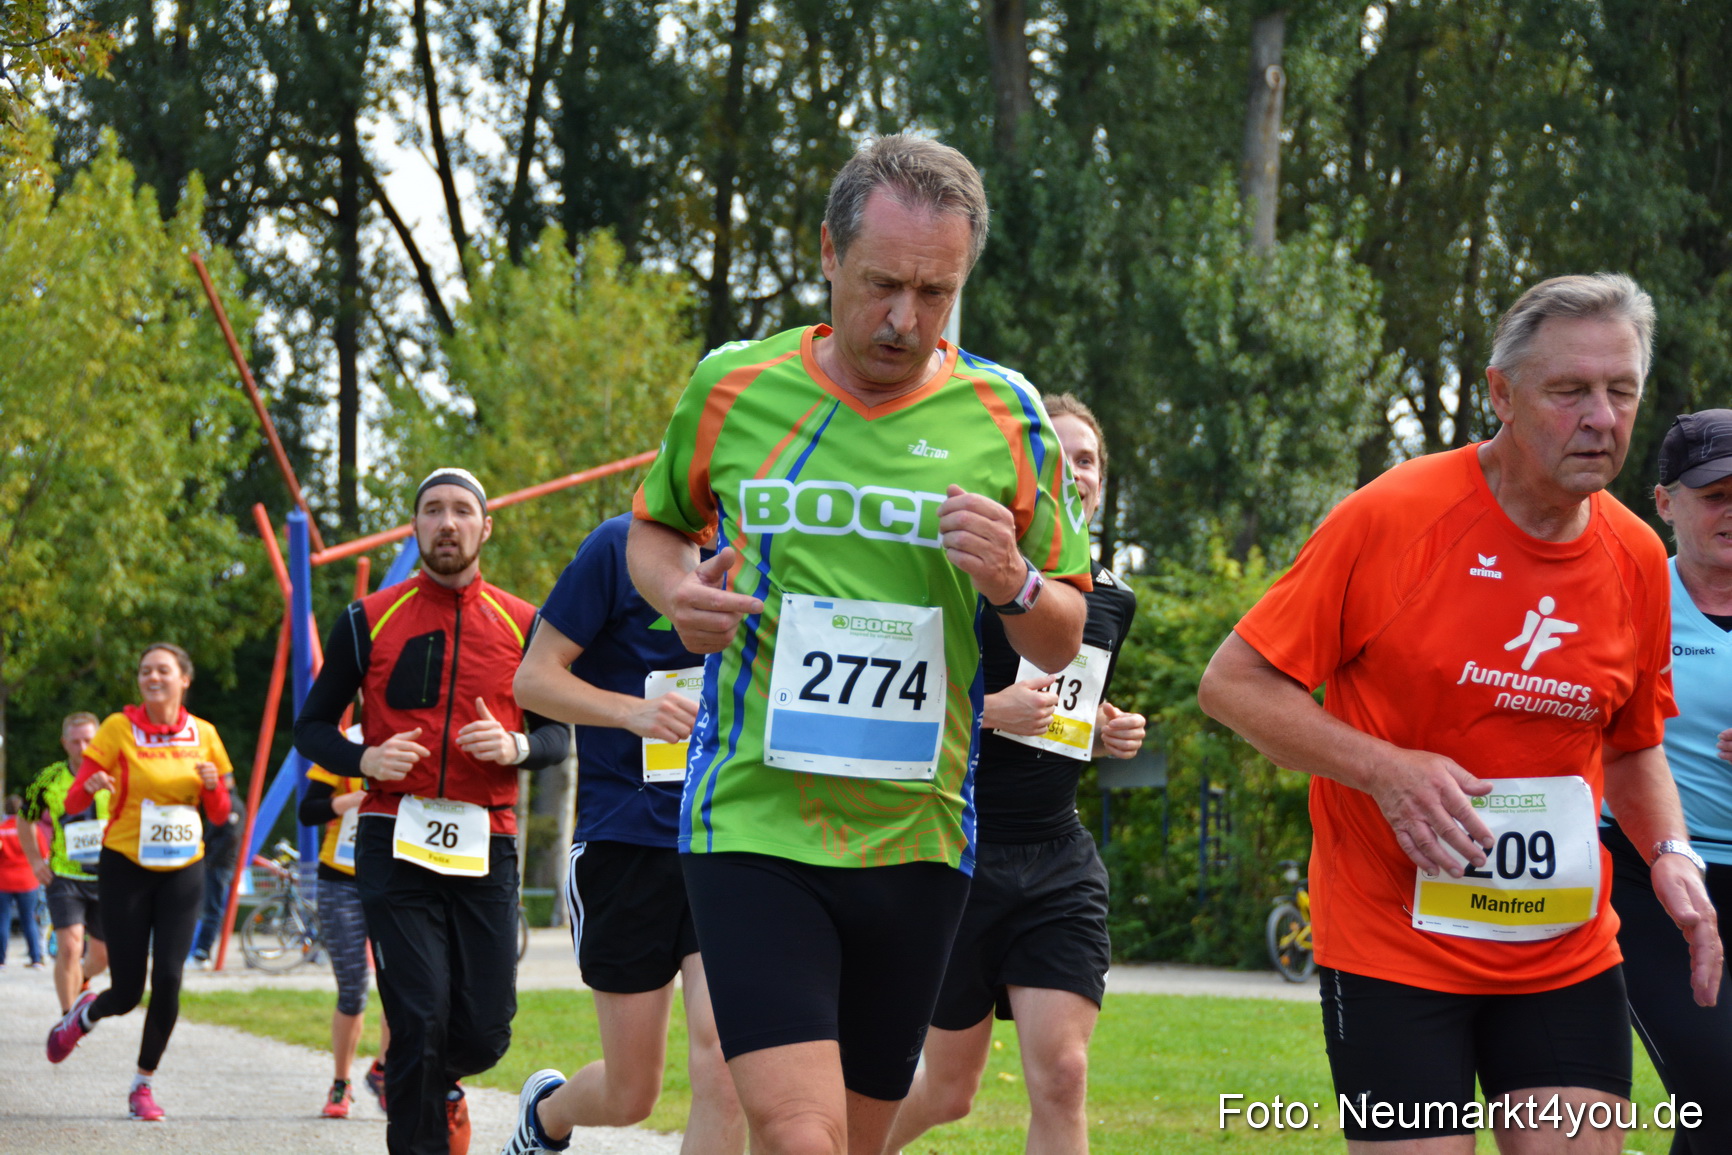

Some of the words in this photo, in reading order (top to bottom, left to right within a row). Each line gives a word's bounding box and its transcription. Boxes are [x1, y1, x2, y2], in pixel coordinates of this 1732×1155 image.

[1470, 567, 1502, 579] erima
[850, 616, 913, 636] BOCK
[1684, 647, 1715, 656] Direkt
[799, 651, 928, 711] 2774
[1457, 661, 1592, 702] funrunners
[1037, 675, 1082, 711] 13
[1494, 692, 1599, 722] neumarkt
[1489, 794, 1546, 809] BOCK
[151, 824, 193, 843] 2635
[425, 821, 459, 848] 26
[1470, 893, 1545, 914] Manfred
